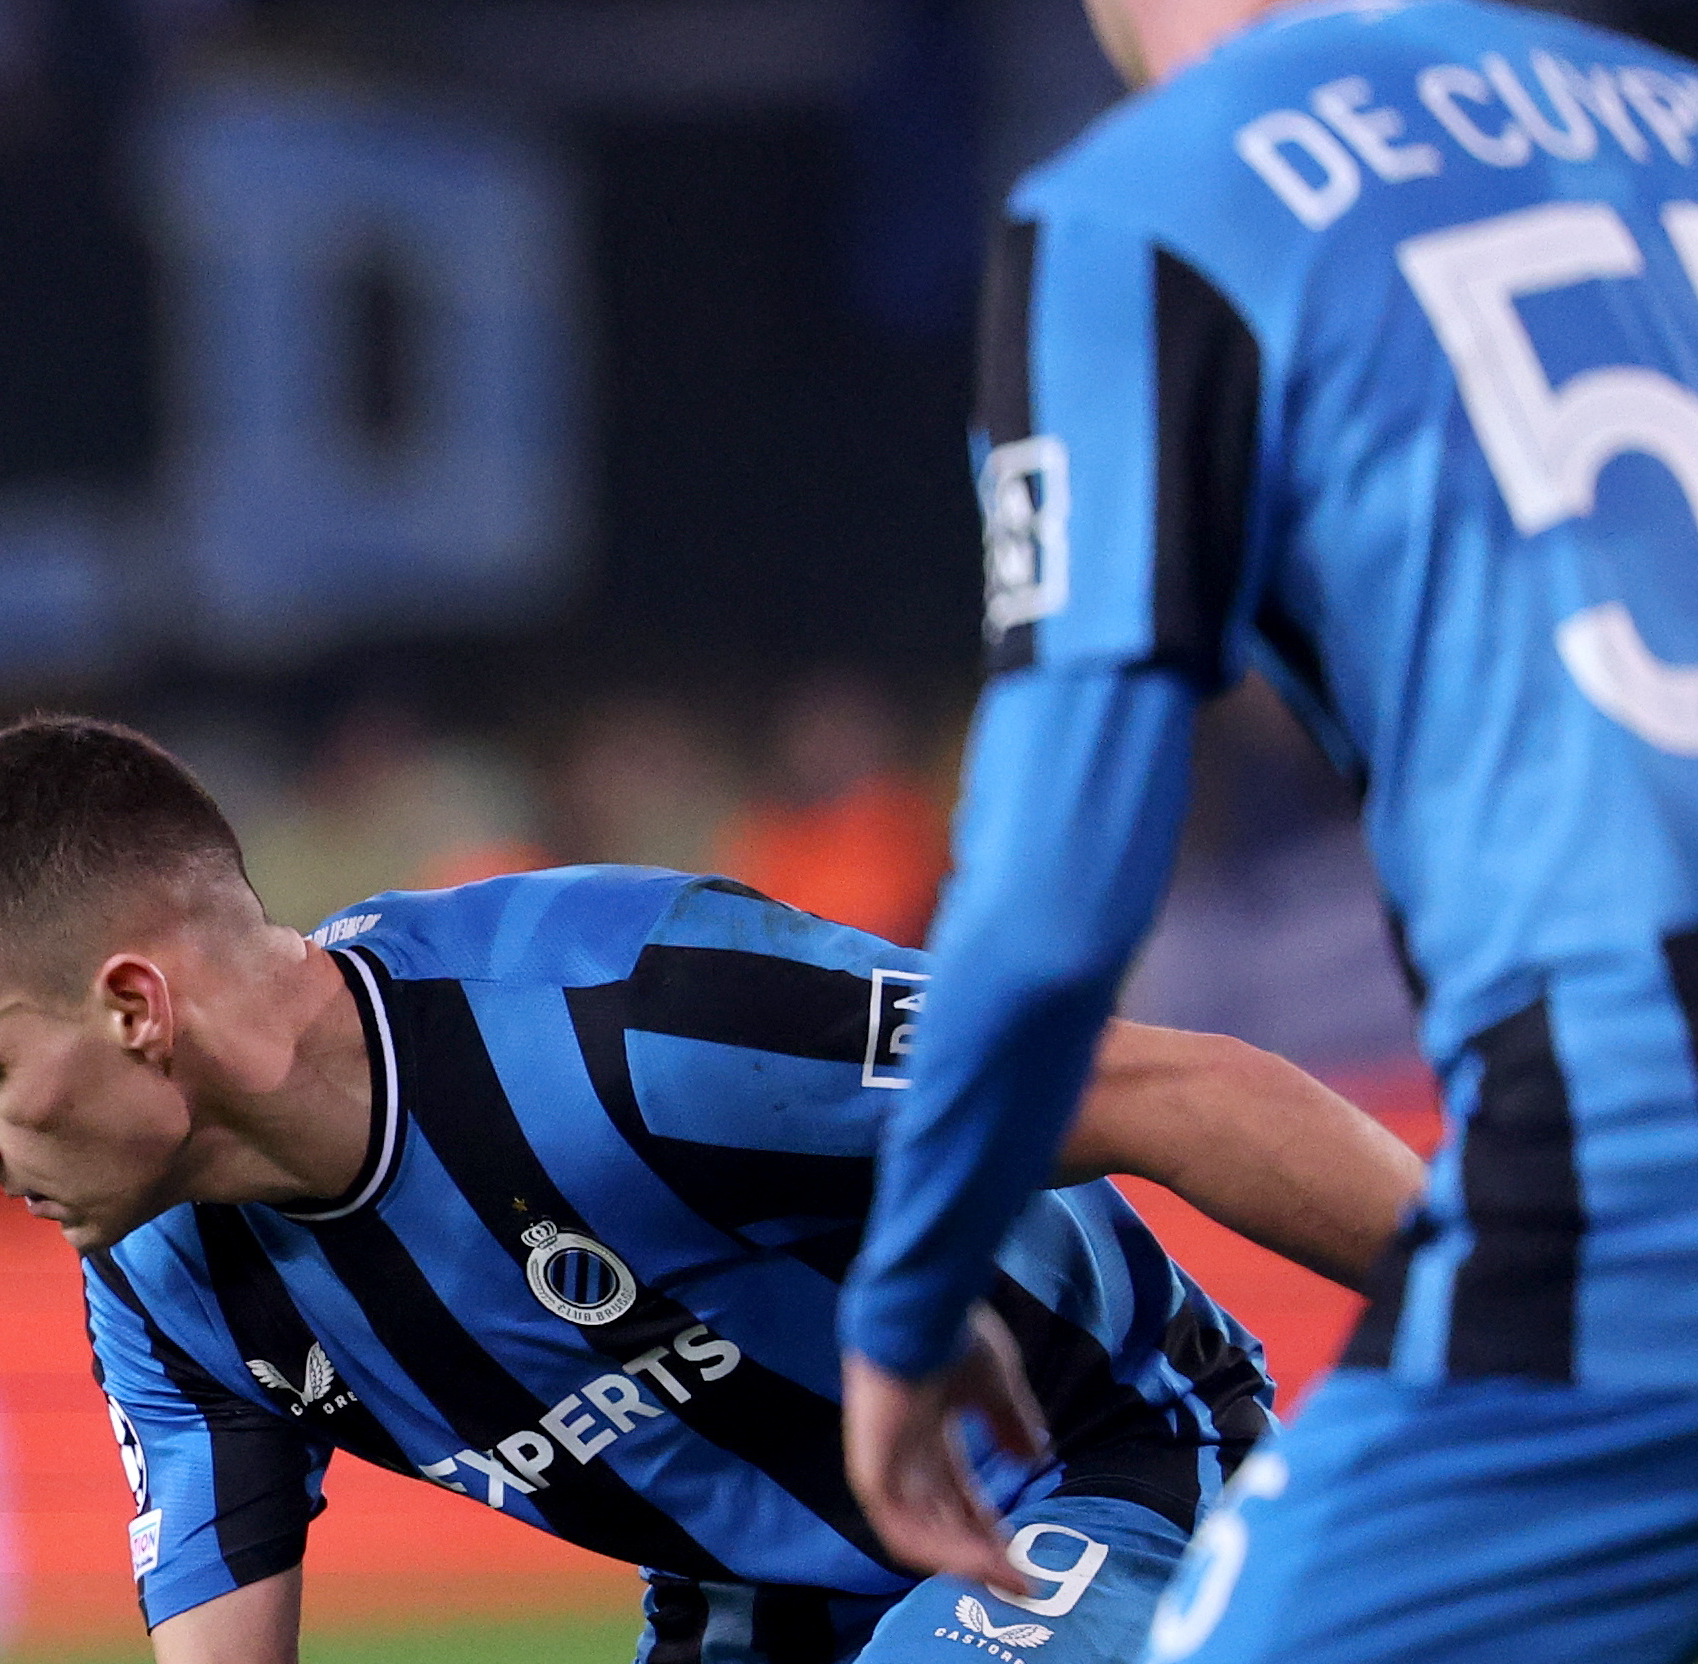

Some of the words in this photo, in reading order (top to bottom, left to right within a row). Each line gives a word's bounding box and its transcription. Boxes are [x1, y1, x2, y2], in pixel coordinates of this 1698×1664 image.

[1232, 74, 1442, 232] DE
[1394, 198, 1698, 758] 5
[557, 1304, 591, 1322] CLUB
[290, 1391, 358, 1417] CORE
[988, 1522, 1109, 1618] 9
